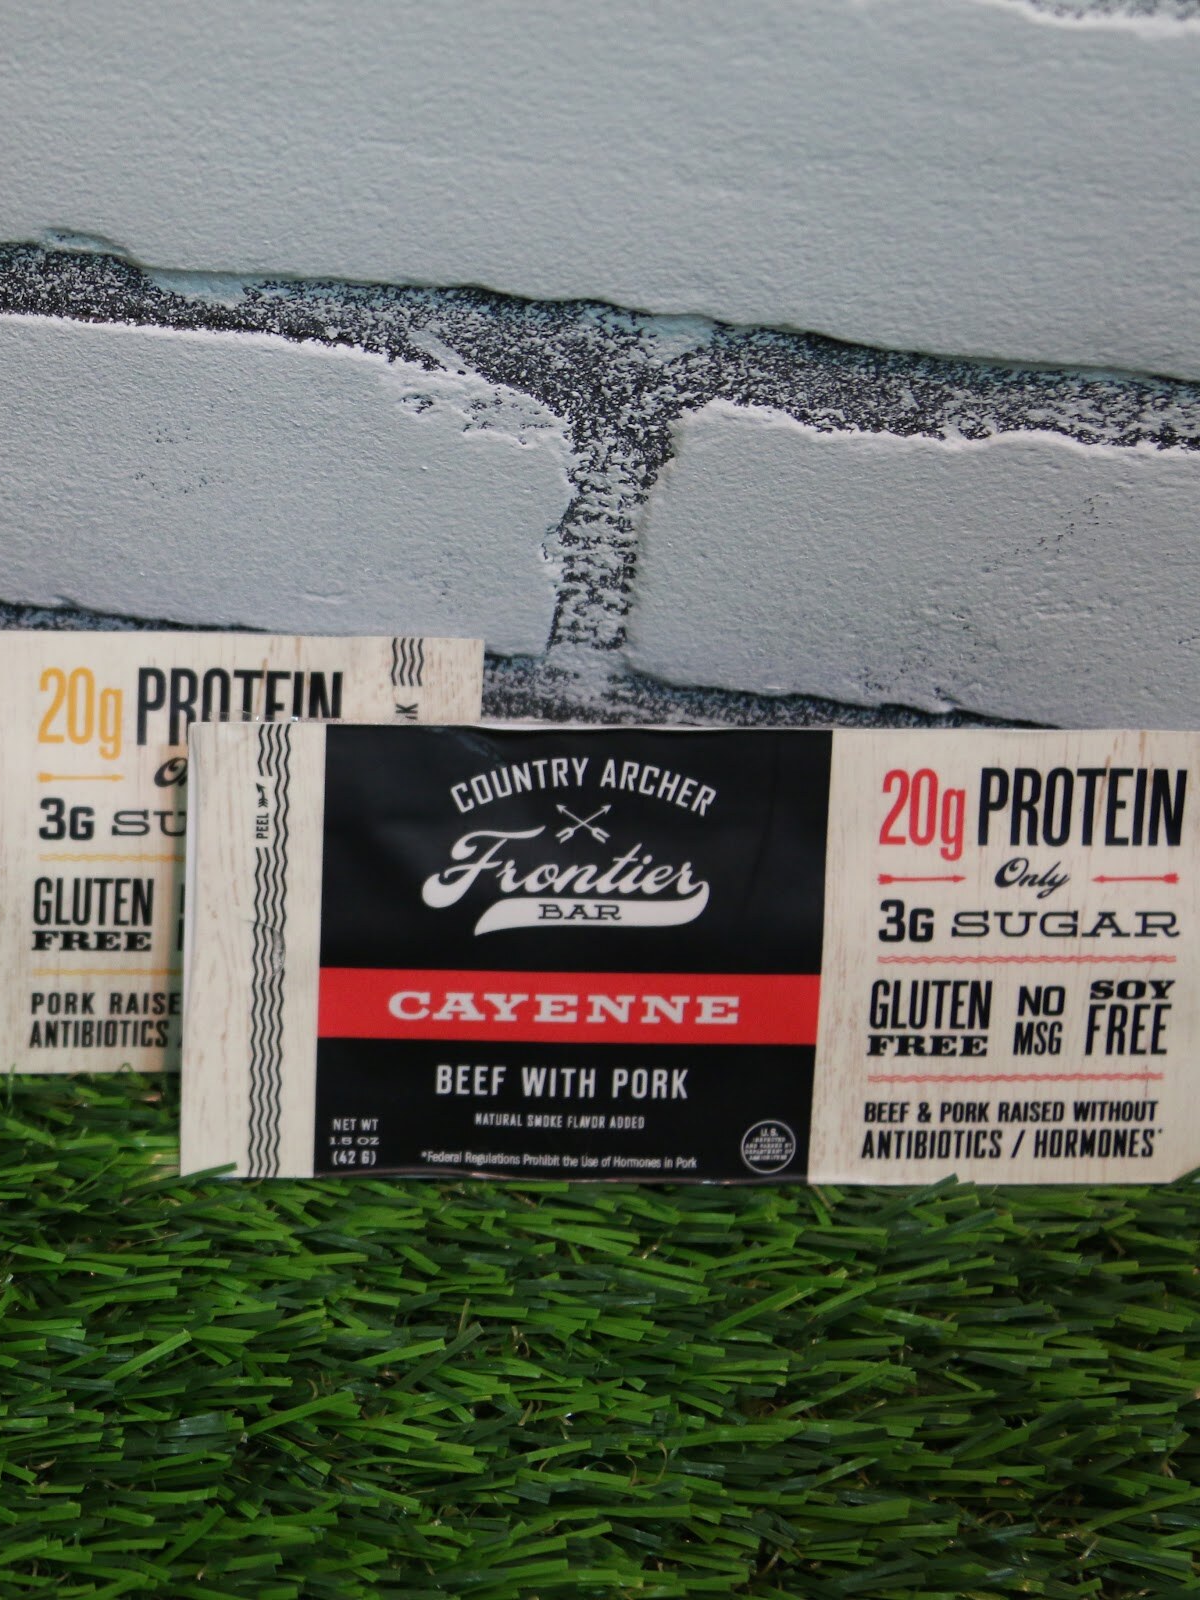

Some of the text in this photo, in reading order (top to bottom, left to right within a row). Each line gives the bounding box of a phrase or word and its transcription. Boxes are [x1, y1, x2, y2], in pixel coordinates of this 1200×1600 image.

[37, 667, 123, 760] 20g
[450, 757, 717, 816] COUNTRY ARCHER
[38, 797, 95, 841] 3G
[256, 812, 269, 839] PEEL
[878, 767, 1188, 861] 20g PROTEIN
[421, 825, 708, 909] Frontier
[994, 857, 1071, 900] Only
[33, 876, 154, 926] GLUTEN
[538, 904, 622, 922] BAR
[878, 899, 1181, 943] 3G SUGAR
[31, 930, 152, 952] FREE
[31, 992, 181, 1016] PORK RAISE
[869, 979, 993, 1030] GLUTEN
[1017, 985, 1066, 1017] NO
[1089, 979, 1176, 1000] SOY
[388, 991, 740, 1025] CAYENNE
[29, 1020, 170, 1048] ANTIBIOTICS
[1013, 1021, 1063, 1056] MSG
[1085, 1003, 1172, 1056] FREE
[866, 1034, 988, 1057] FREE
[435, 1064, 689, 1100] BEEF WITH PORK
[333, 1118, 379, 1131] NET WT
[475, 1112, 645, 1130] NATURAL SMOKE FLAVOR ADDED
[864, 1100, 1159, 1124] BEEF & PORK RAISED WITHOUT
[329, 1136, 380, 1146] 1.5 OZ
[861, 1129, 1003, 1160] ANTIBIOTICS
[332, 1150, 356, 1166] (42
[465, 1152, 520, 1166] Regulations
[522, 1153, 560, 1167] Prohibit
[563, 1154, 578, 1167] the
[581, 1155, 599, 1168] Use
[601, 1155, 611, 1168] of
[613, 1156, 662, 1169] Hormones
[664, 1156, 673, 1169] in
[676, 1156, 697, 1169] Pork
